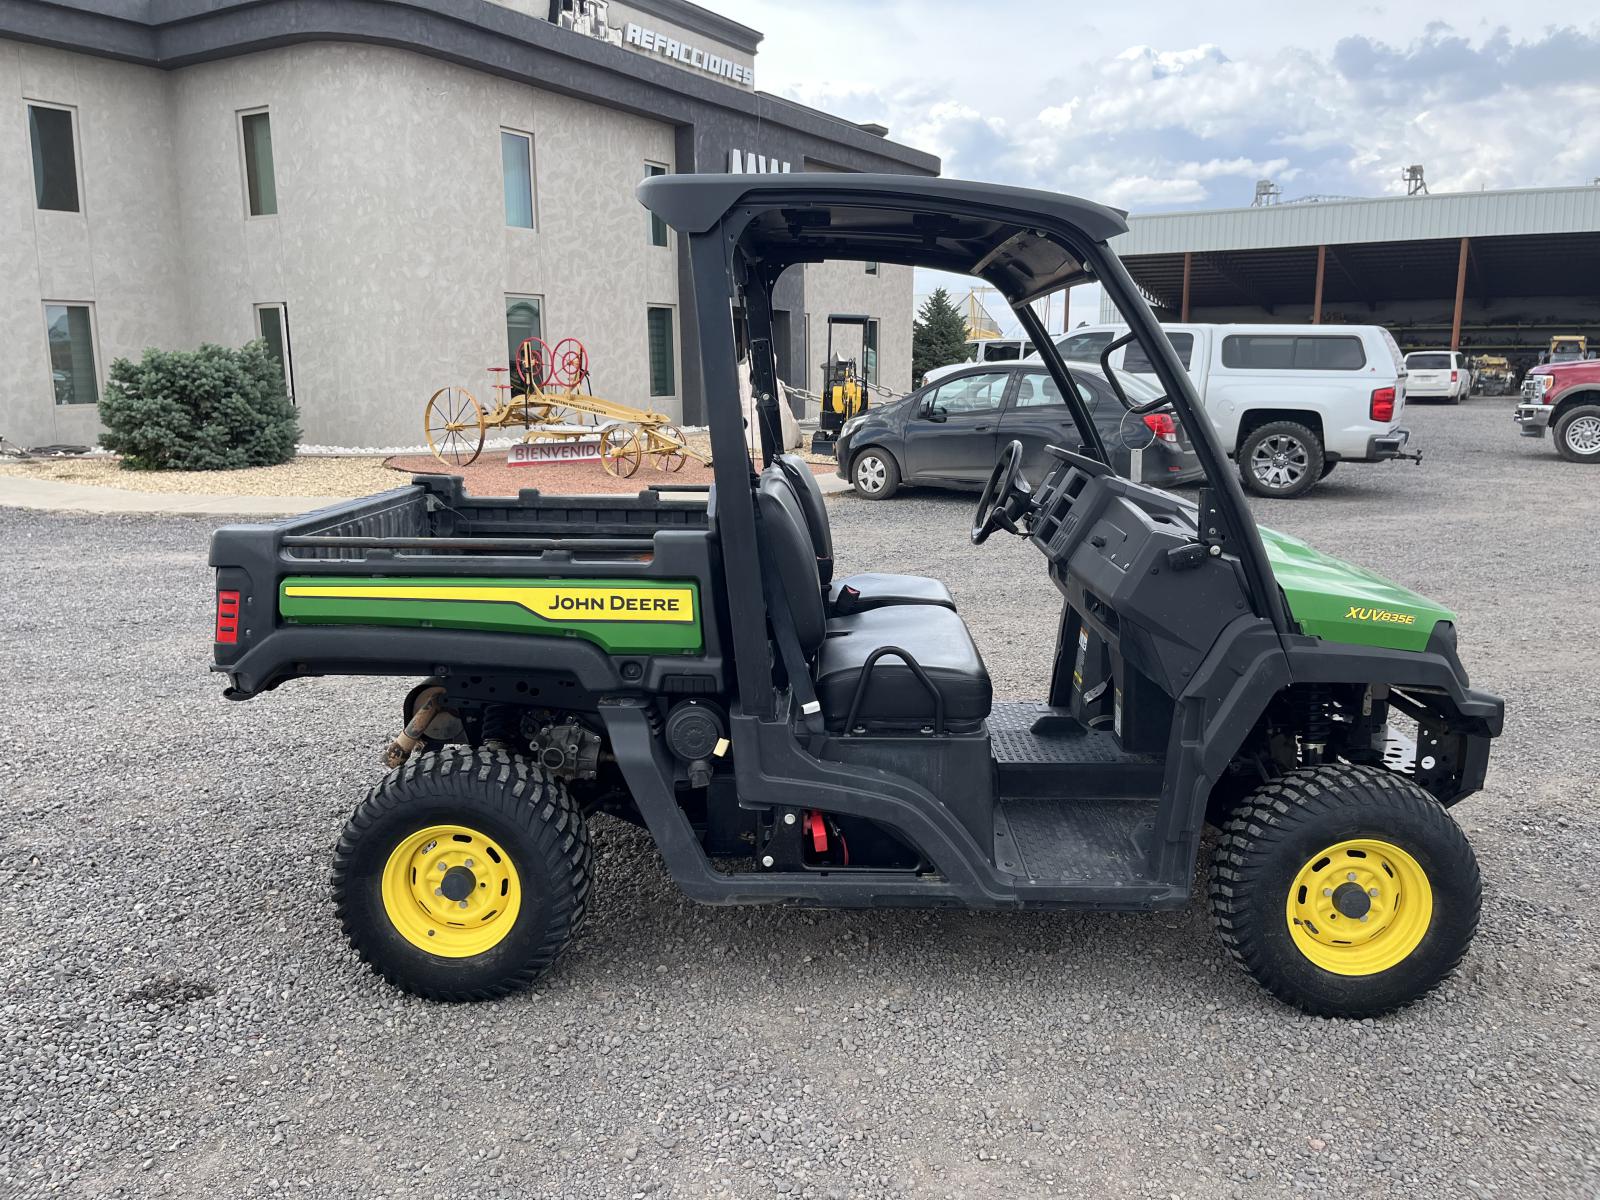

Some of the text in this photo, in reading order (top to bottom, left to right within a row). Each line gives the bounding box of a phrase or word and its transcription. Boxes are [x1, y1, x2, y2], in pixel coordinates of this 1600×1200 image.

[625, 23, 754, 86] REFACCIONES
[549, 595, 680, 611] JOHN DEERE
[1345, 606, 1415, 624] XUV835E
